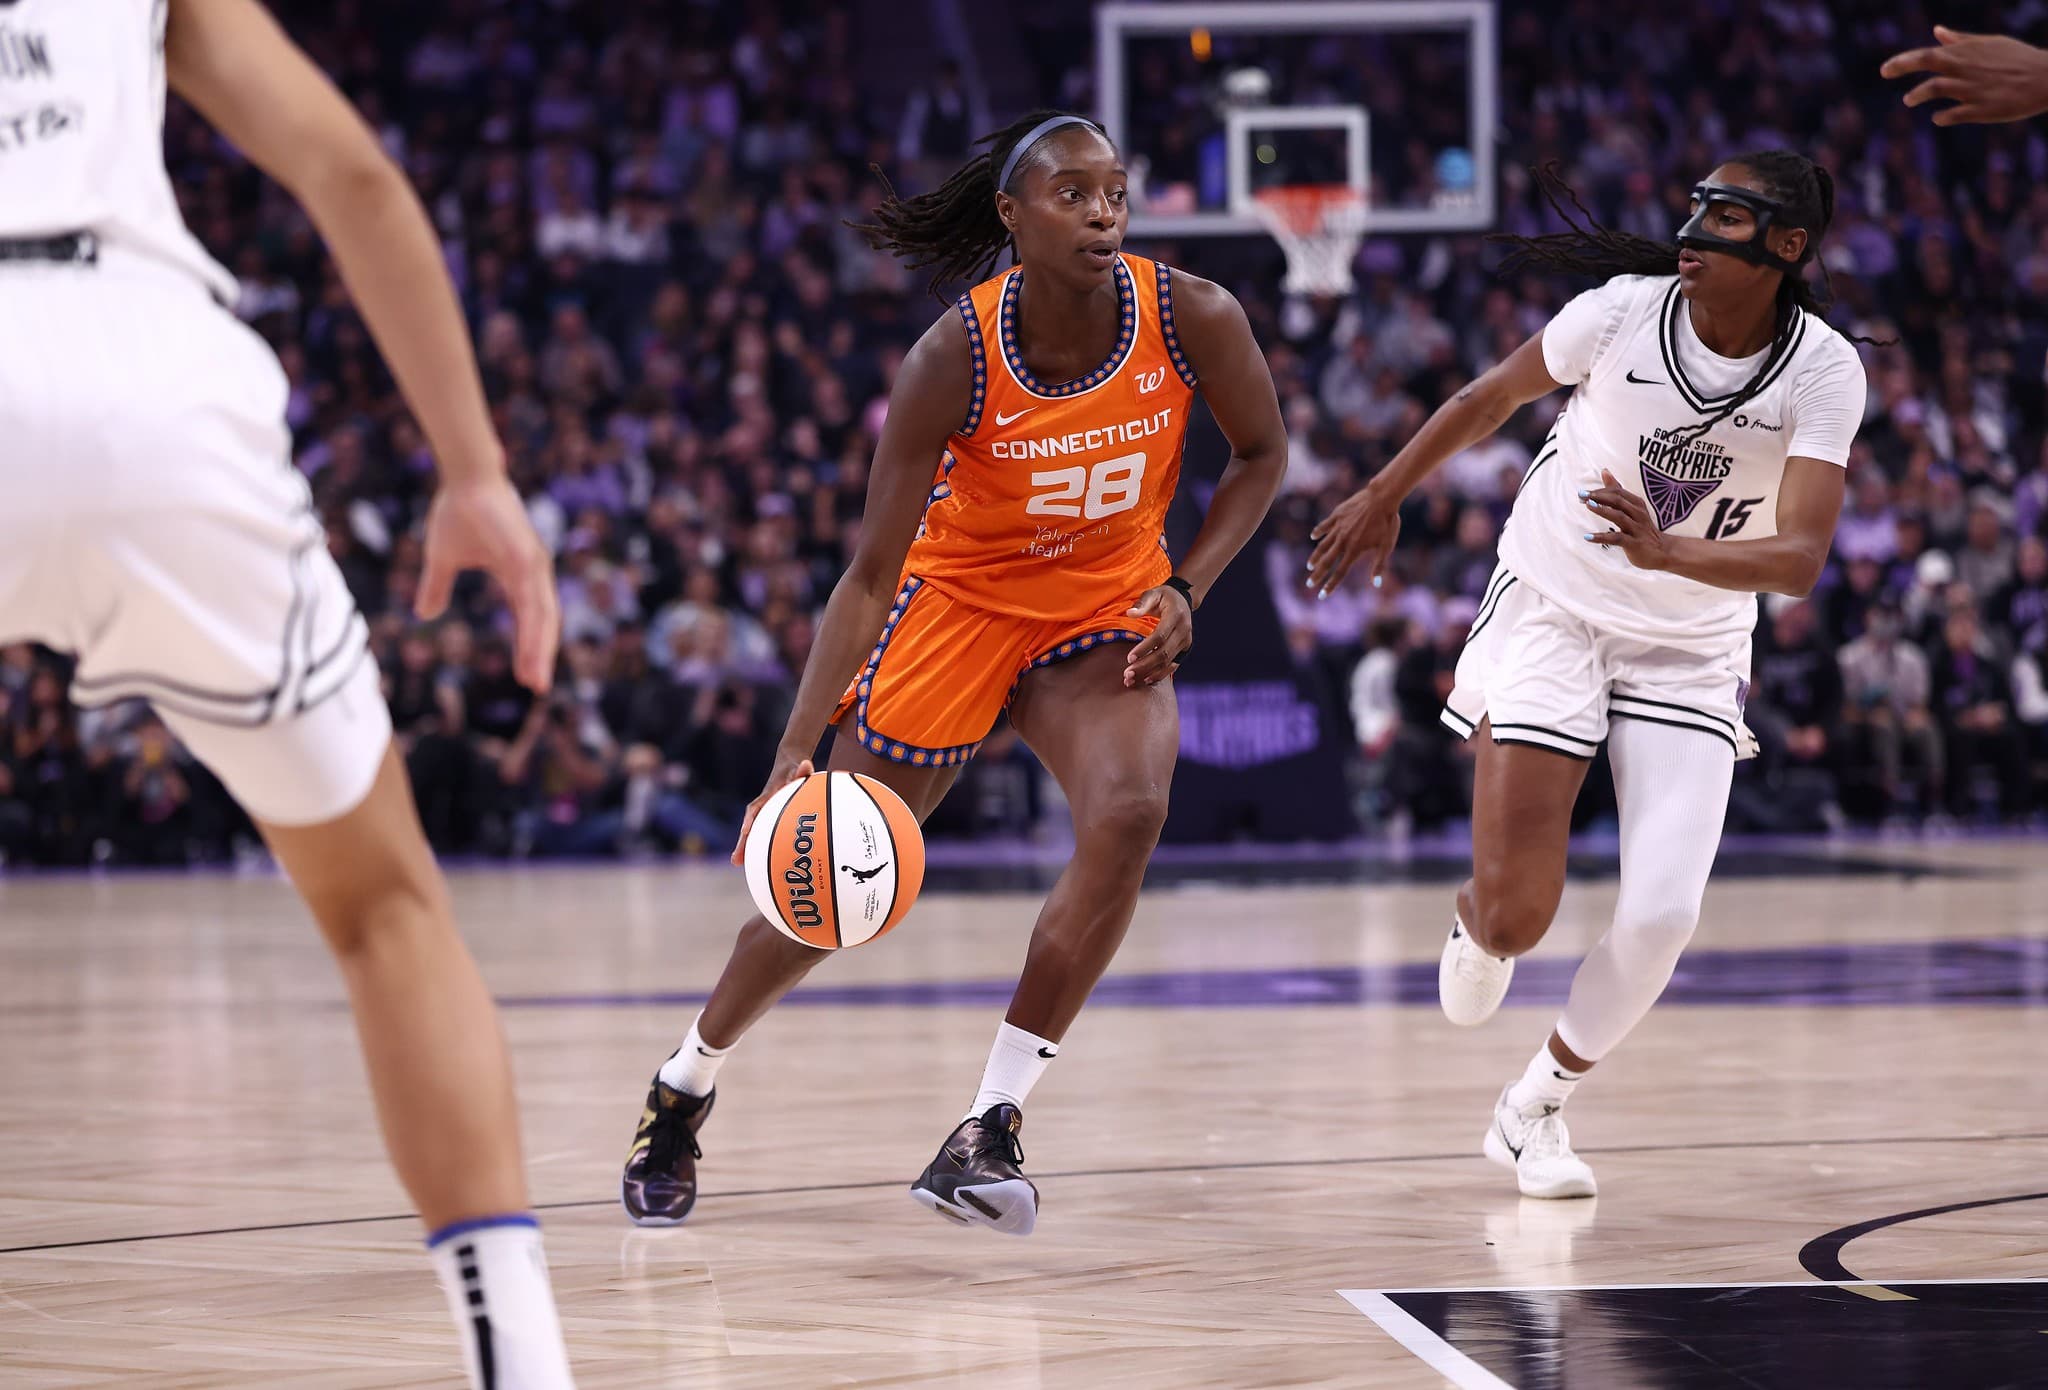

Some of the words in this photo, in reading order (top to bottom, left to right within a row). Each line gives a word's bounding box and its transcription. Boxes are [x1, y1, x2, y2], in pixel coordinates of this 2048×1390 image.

[991, 408, 1172, 459] CONNECTICUT
[1638, 434, 1734, 479] VALKYRIES
[1653, 427, 1691, 448] GOLDE
[1694, 440, 1726, 455] STATE
[1025, 452, 1147, 520] 28
[1704, 495, 1767, 541] 15
[784, 812, 824, 929] Wilson
